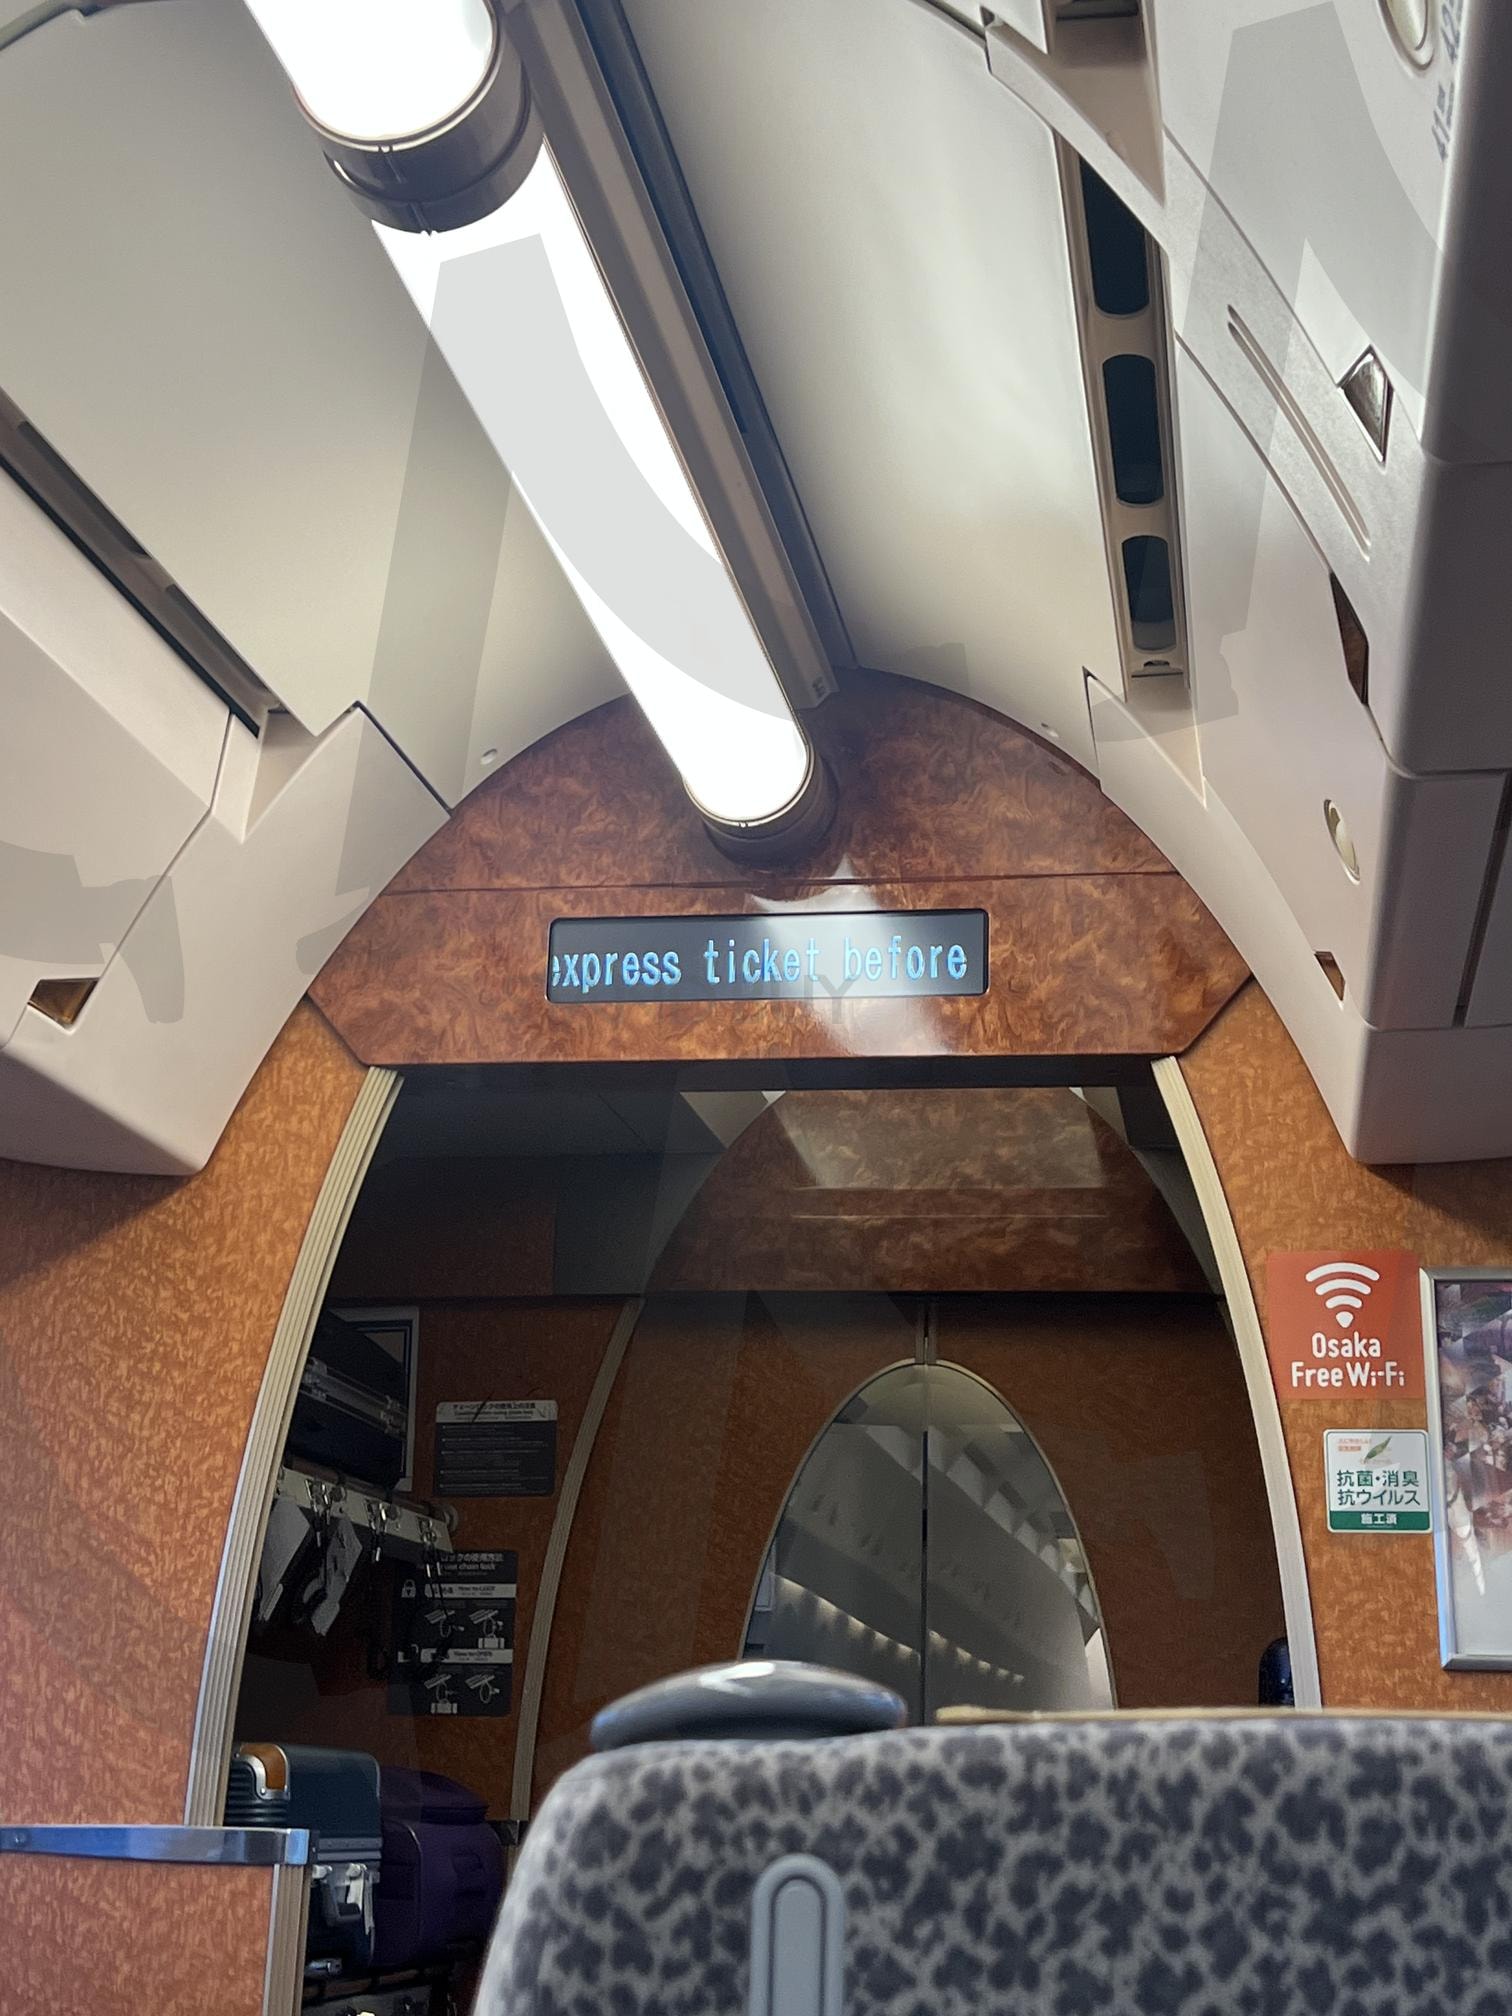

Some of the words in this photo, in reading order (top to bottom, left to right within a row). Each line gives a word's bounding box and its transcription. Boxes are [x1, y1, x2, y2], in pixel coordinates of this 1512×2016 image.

[703, 937, 820, 984] ticket
[842, 935, 968, 981] before
[1312, 1332, 1380, 1358] Osaka
[1292, 1362, 1342, 1387] Free
[1347, 1362, 1404, 1387] Wi-Fi
[1337, 1470, 1419, 1487] 抗菌・消臭
[1337, 1489, 1421, 1507] 抗ウイルス
